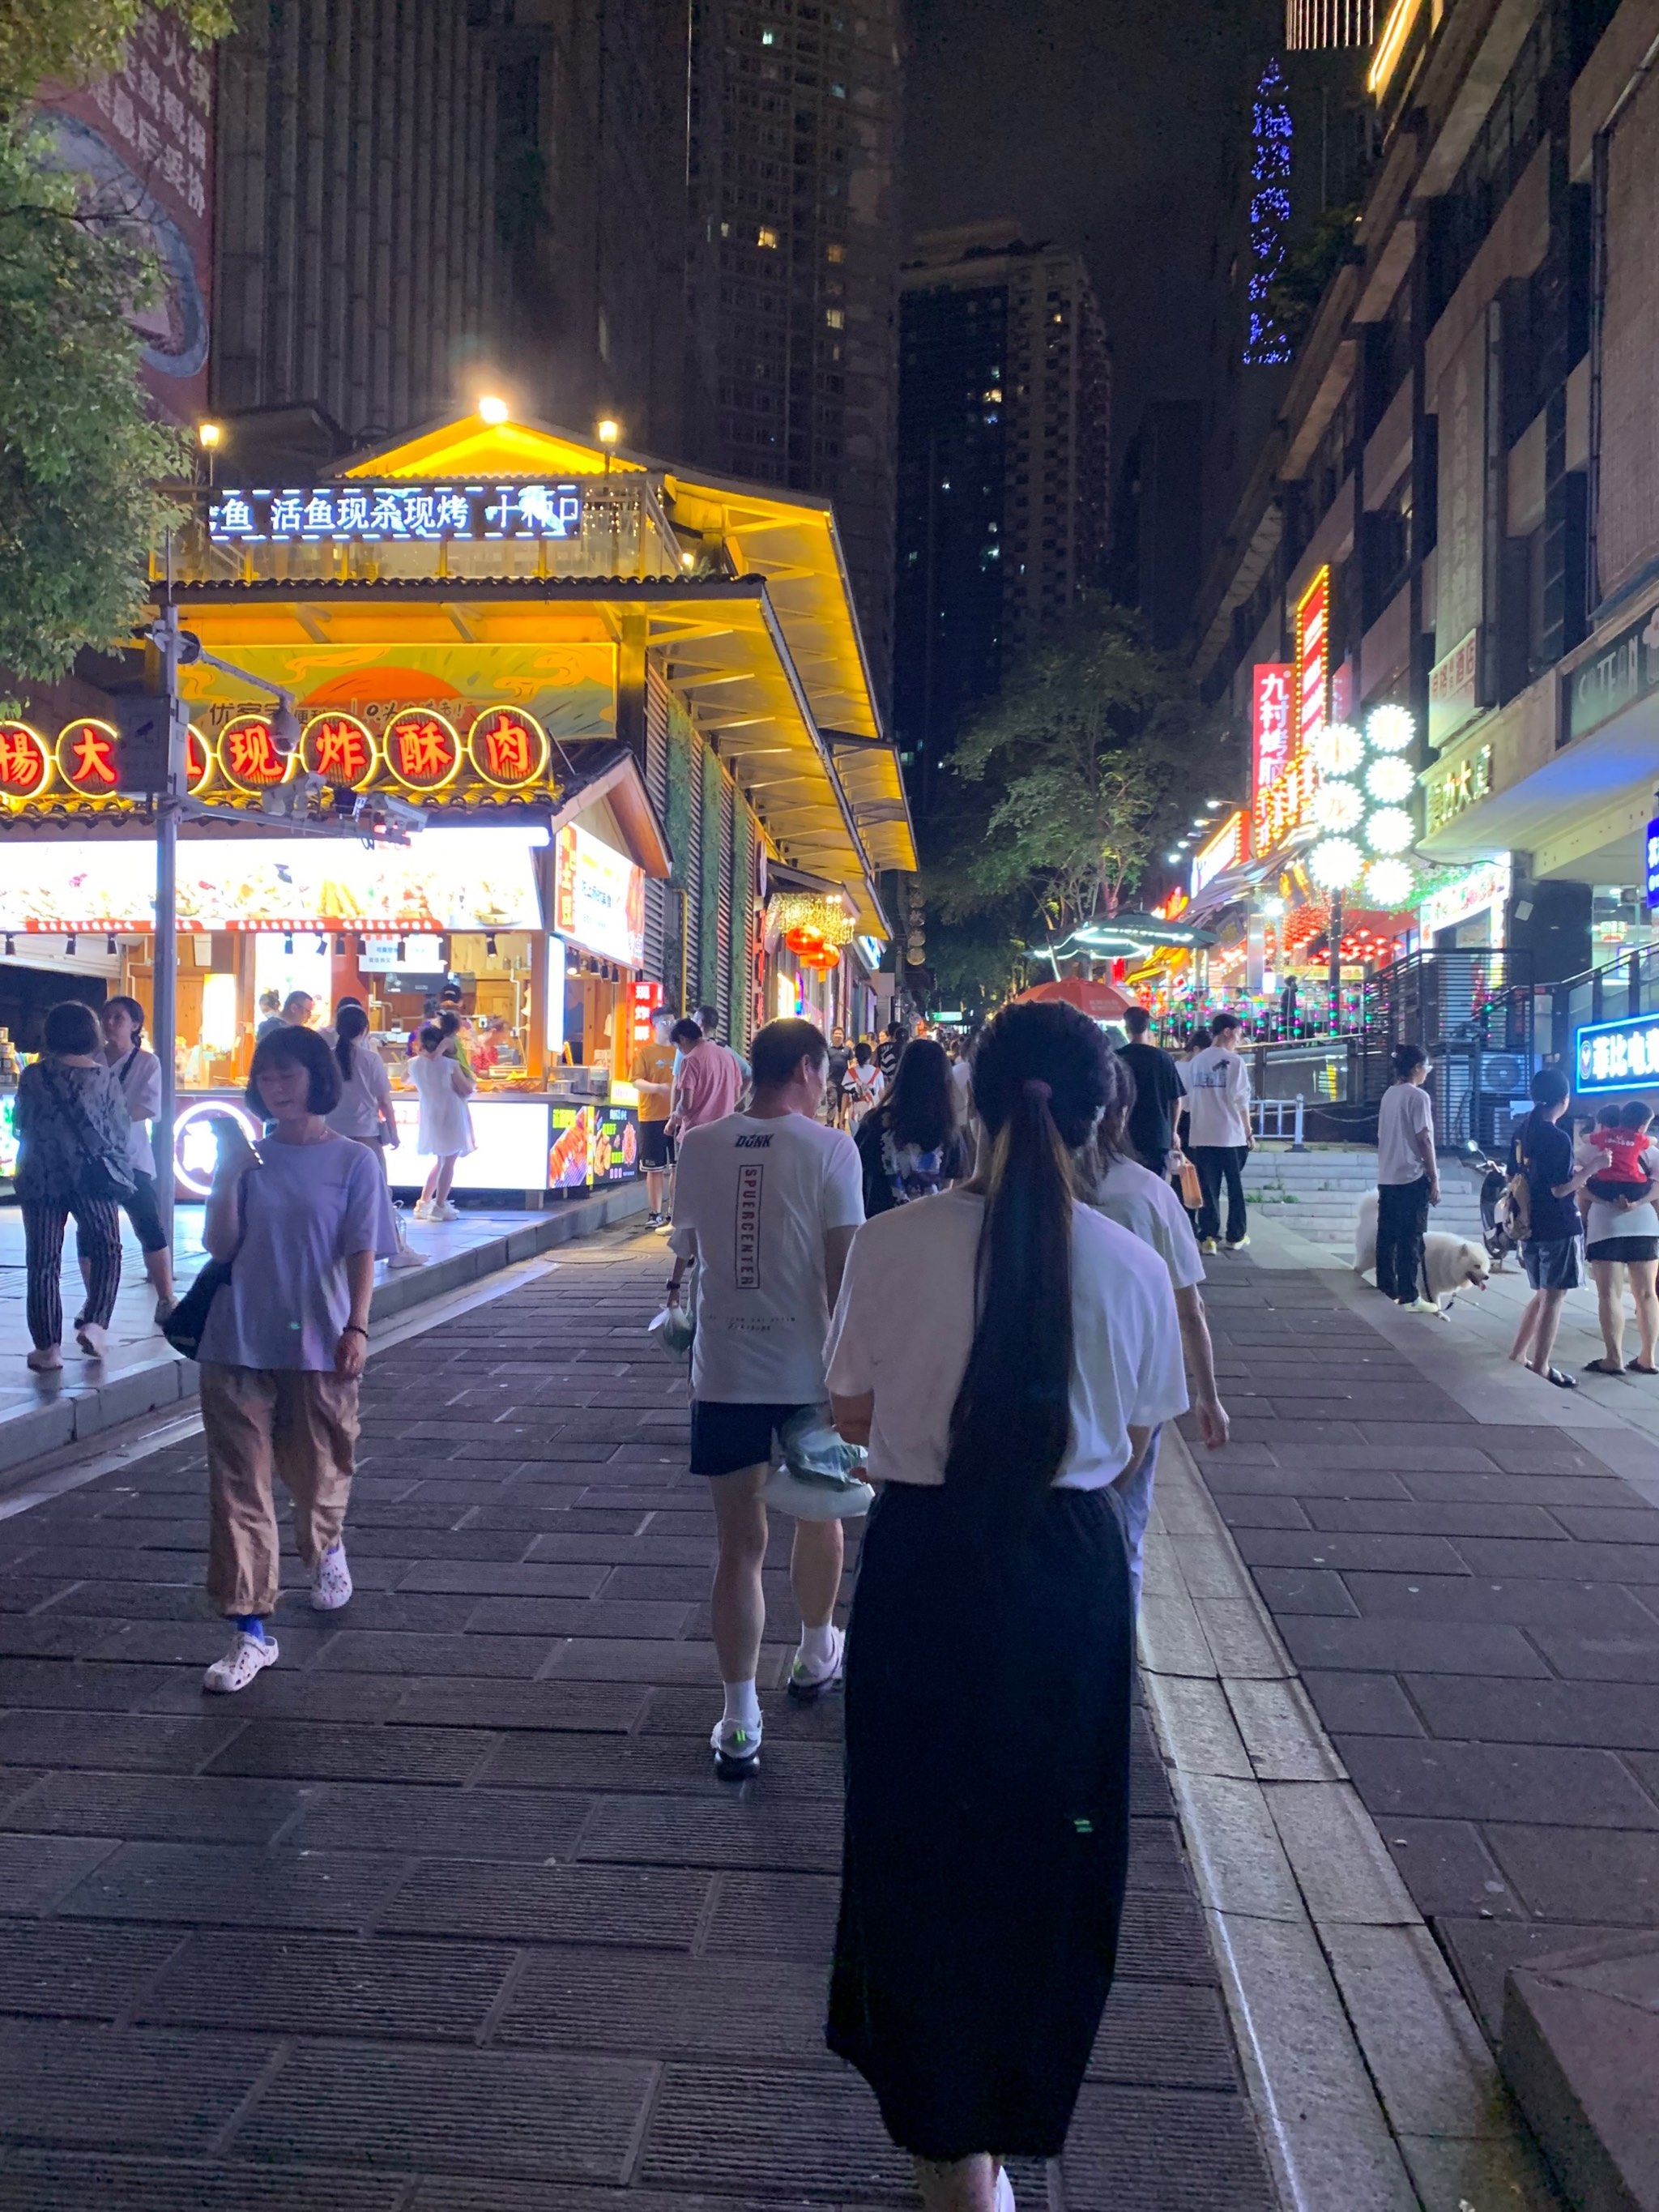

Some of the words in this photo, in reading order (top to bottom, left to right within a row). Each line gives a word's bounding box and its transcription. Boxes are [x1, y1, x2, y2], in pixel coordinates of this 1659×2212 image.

[271, 494, 468, 532] 活鱼现杀现烤
[0, 715, 531, 786] 楊大现炸酥肉
[740, 1169, 757, 1285] SPUERCENTER
